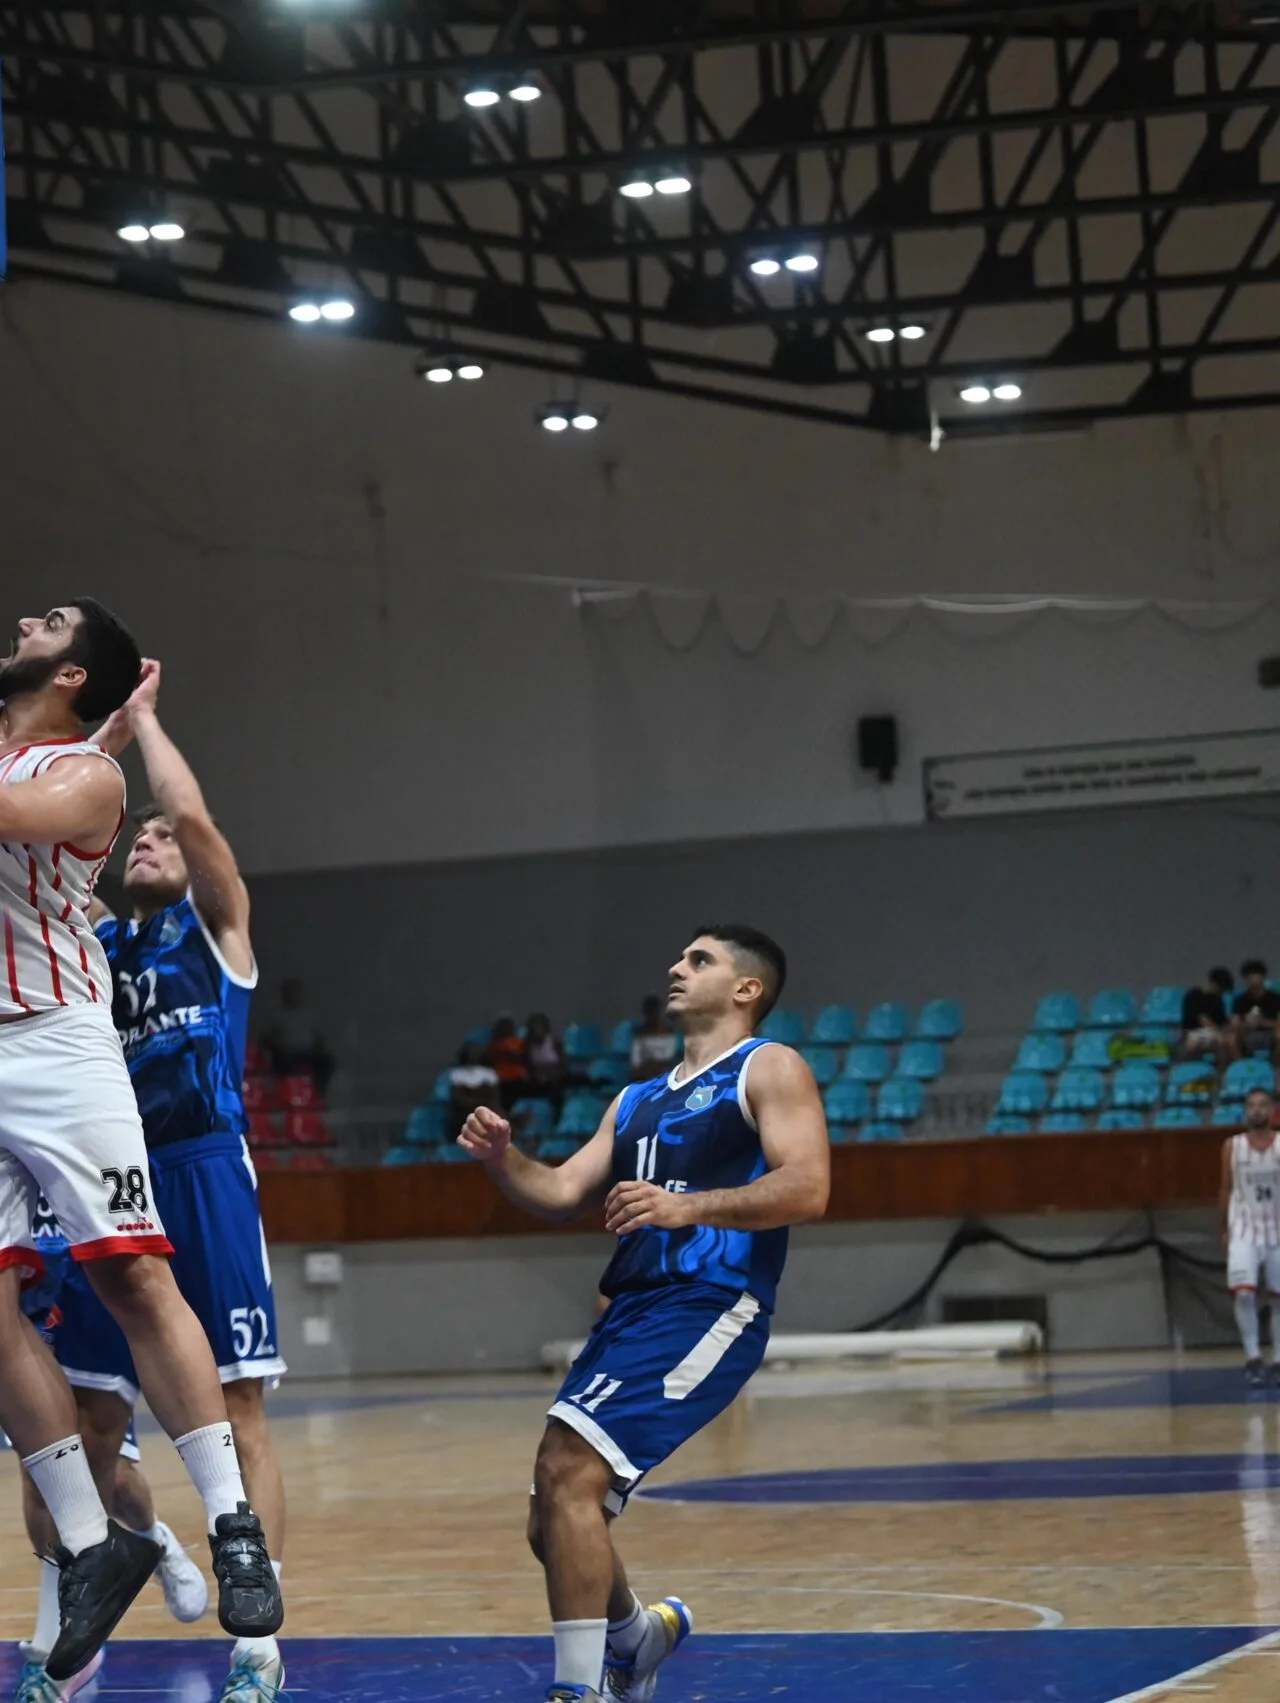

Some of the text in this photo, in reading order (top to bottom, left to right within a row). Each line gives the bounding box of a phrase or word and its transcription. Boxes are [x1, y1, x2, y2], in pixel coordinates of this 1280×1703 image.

[636, 1131, 659, 1182] 11
[100, 1165, 149, 1214] 28
[230, 1306, 275, 1358] 52
[568, 1373, 623, 1413] 11
